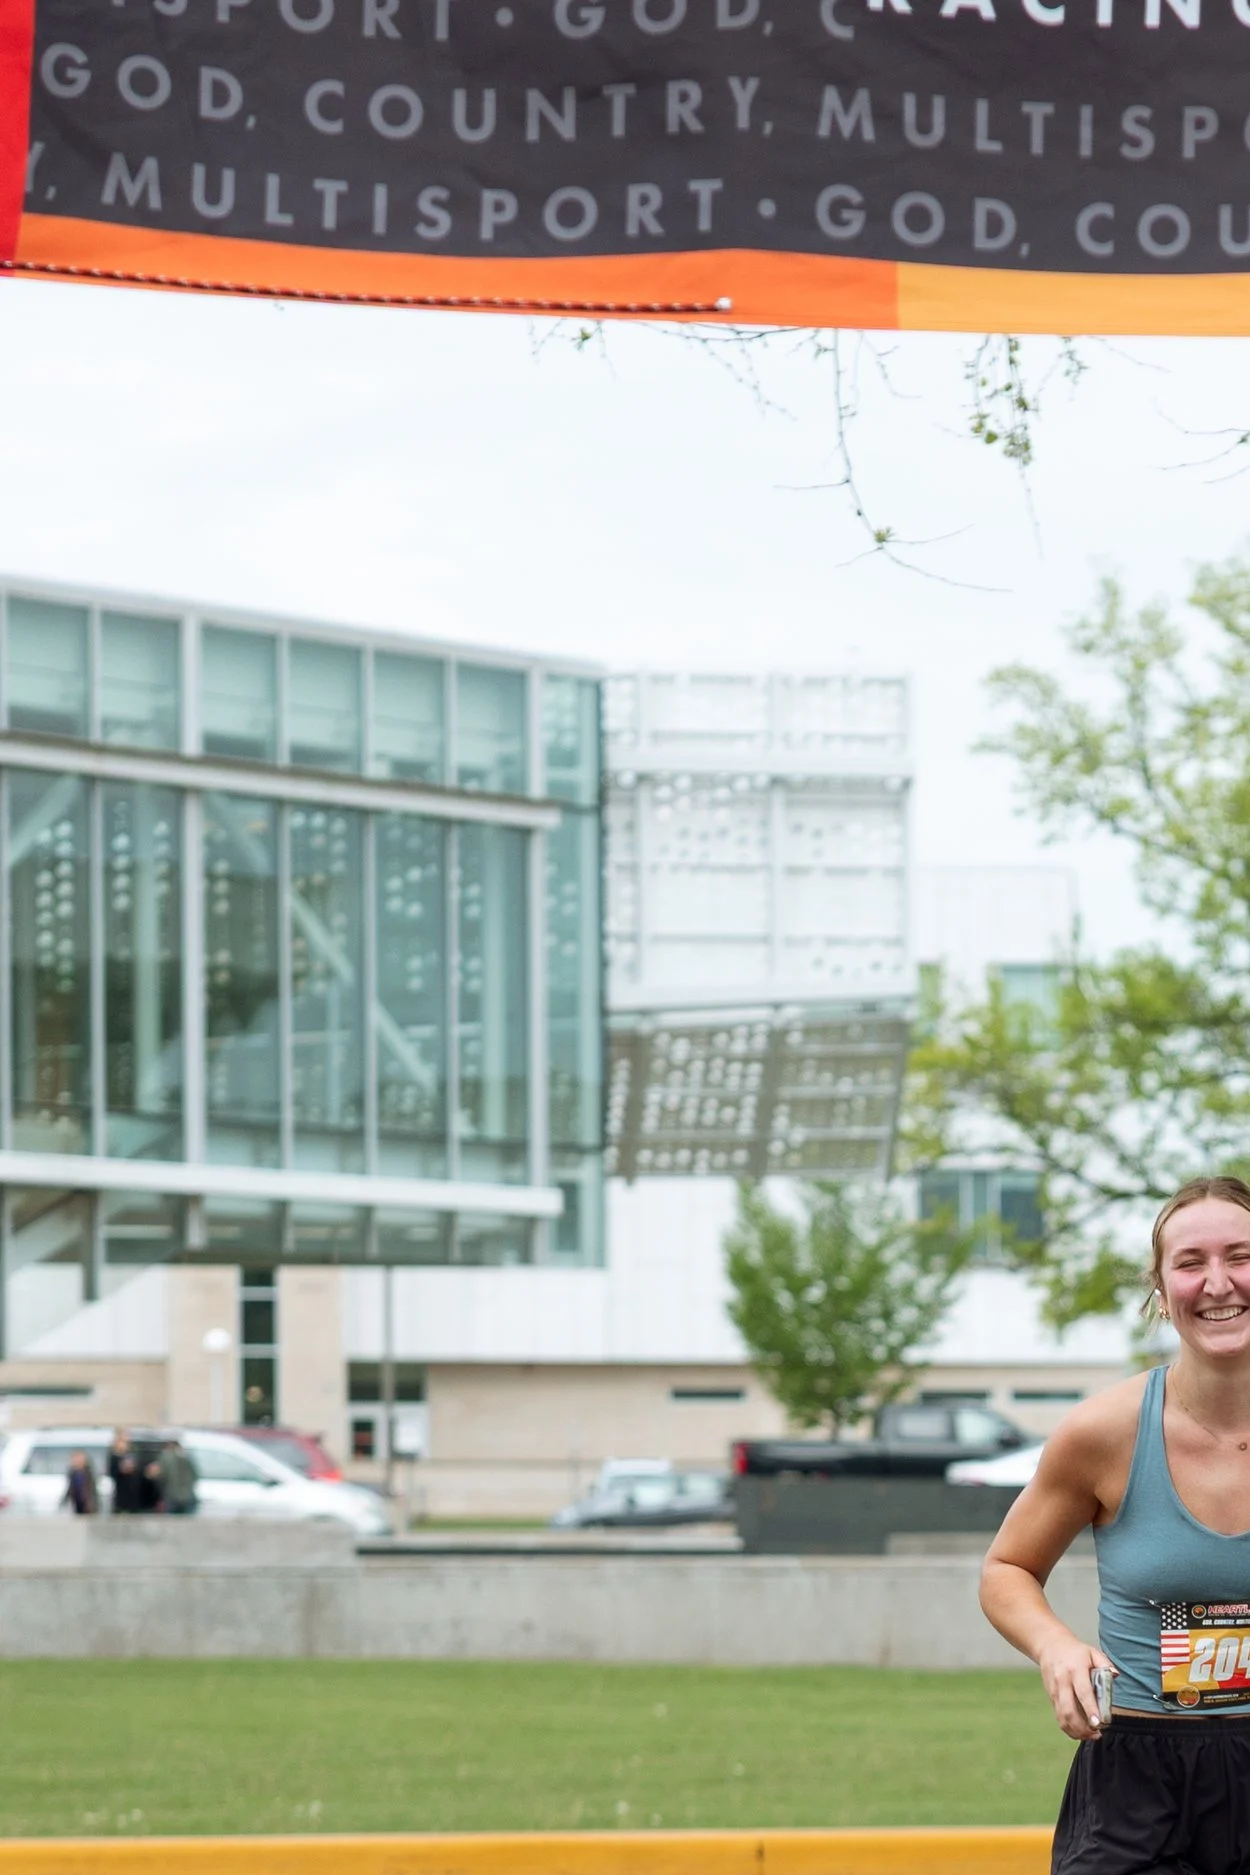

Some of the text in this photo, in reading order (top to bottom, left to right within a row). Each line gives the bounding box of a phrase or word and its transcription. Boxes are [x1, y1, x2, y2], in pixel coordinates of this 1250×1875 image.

[40, 43, 257, 130] GOD,
[303, 75, 774, 143] COUNTRY,
[100, 153, 724, 242] MULTISPORT
[814, 183, 1031, 259] GOD,
